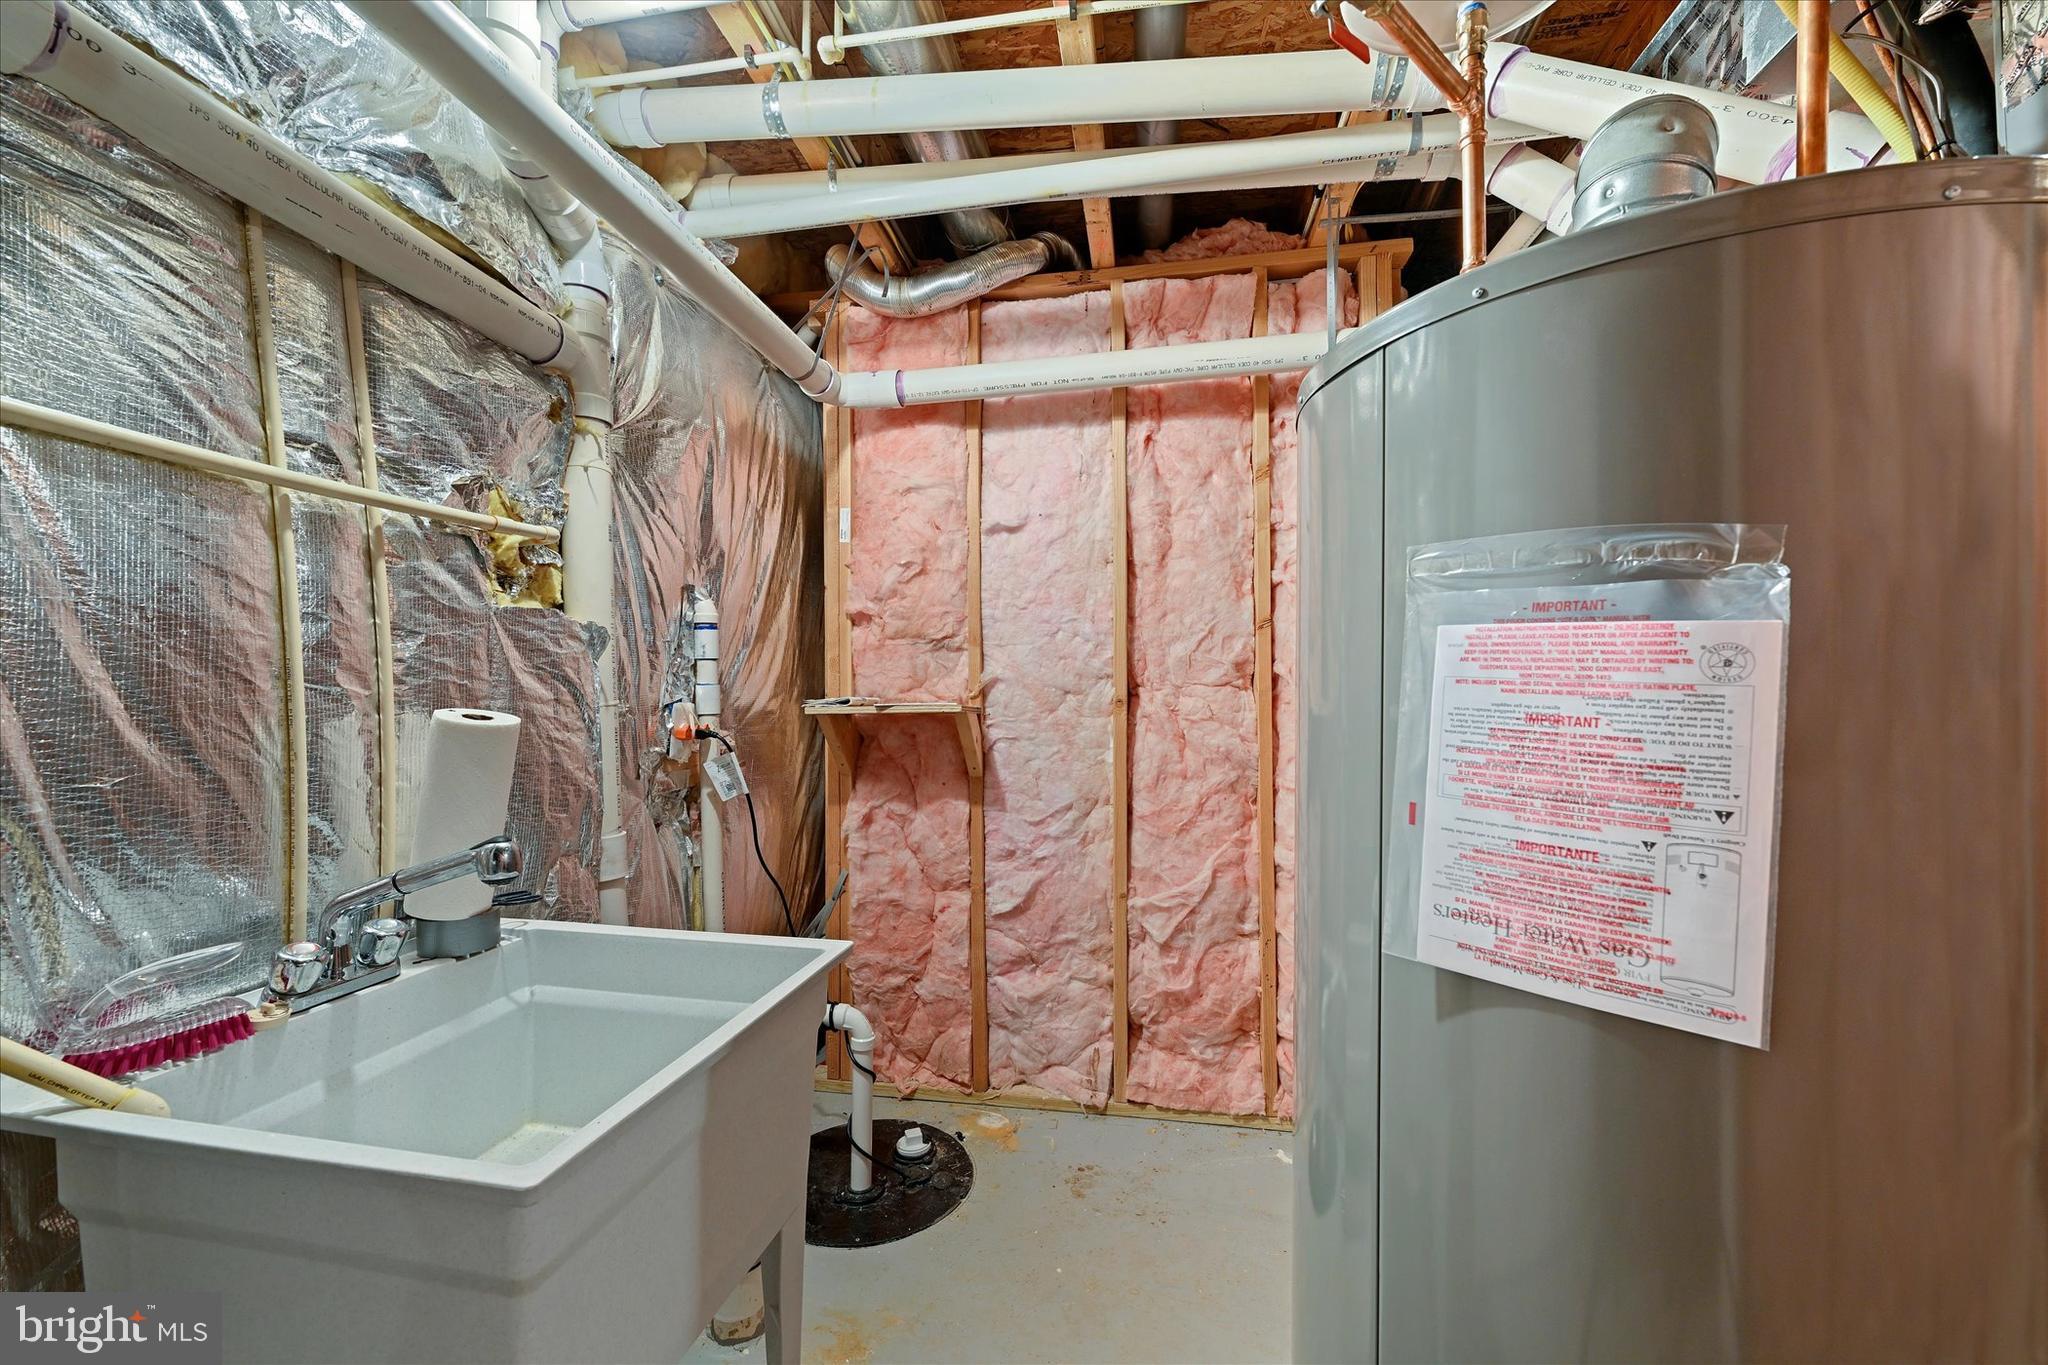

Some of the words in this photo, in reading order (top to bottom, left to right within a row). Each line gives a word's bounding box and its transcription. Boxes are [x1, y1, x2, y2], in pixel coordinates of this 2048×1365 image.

[1552, 67, 1573, 77] CORE
[1574, 71, 1616, 87] CELLULAR
[1619, 81, 1641, 93] COEX
[1745, 108, 1794, 126] 4300
[1321, 149, 1406, 165] CHARLOTTE
[187, 102, 211, 122] IPS
[215, 119, 241, 140] SCH
[243, 136, 261, 152] 40
[263, 150, 293, 172] COEX
[294, 169, 346, 205] CELLULAR
[345, 201, 372, 221] CORE
[410, 243, 433, 261] PIPE
[431, 256, 454, 275] ASTM
[1211, 362, 1235, 370] CELLULAR
[1030, 379, 1047, 387] FOR
[1531, 599, 1607, 613] IMPORTANT
[1525, 712, 1600, 728] IMPORTANT
[1515, 840, 1600, 863] IMPORTANTE
[1432, 903, 1512, 938] Heaters
[1519, 924, 1590, 956] Water
[1599, 941, 1650, 968] Gas
